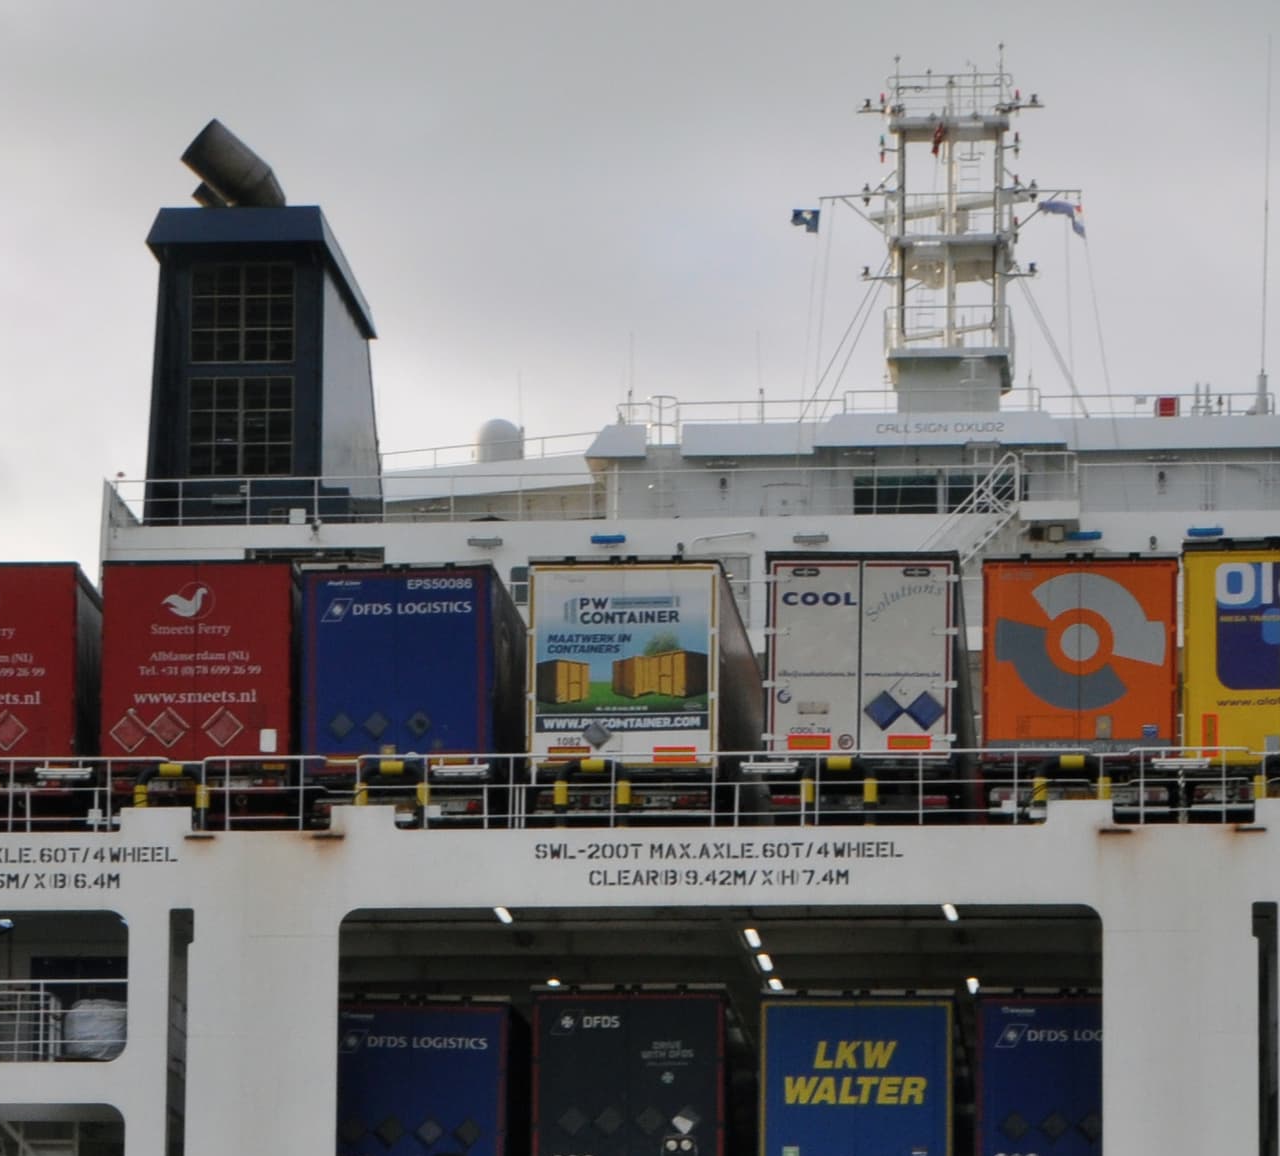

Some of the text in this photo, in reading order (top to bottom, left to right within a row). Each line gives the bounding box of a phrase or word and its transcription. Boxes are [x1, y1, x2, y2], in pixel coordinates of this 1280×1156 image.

[876, 424, 909, 434] CALL
[914, 422, 948, 433] SIGN
[579, 597, 609, 610] PW
[782, 592, 857, 606] COOL
[866, 584, 944, 622] Solutions
[353, 601, 473, 615] DFDS LOGISTICS
[580, 611, 680, 624] CONTAINER
[151, 623, 231, 636] Smeets Ferry
[546, 634, 615, 643] MAATWERK
[547, 644, 620, 654] CONTAINERS
[134, 689, 257, 704] www.smeets.nl
[535, 843, 643, 859] SWL-200T
[583, 1016, 620, 1029] DFDS
[367, 1035, 488, 1050] DFDS LOGISTICS
[1027, 1030, 1068, 1042] DFDS
[813, 1040, 898, 1069] LKW
[784, 1076, 928, 1105] WALTER
